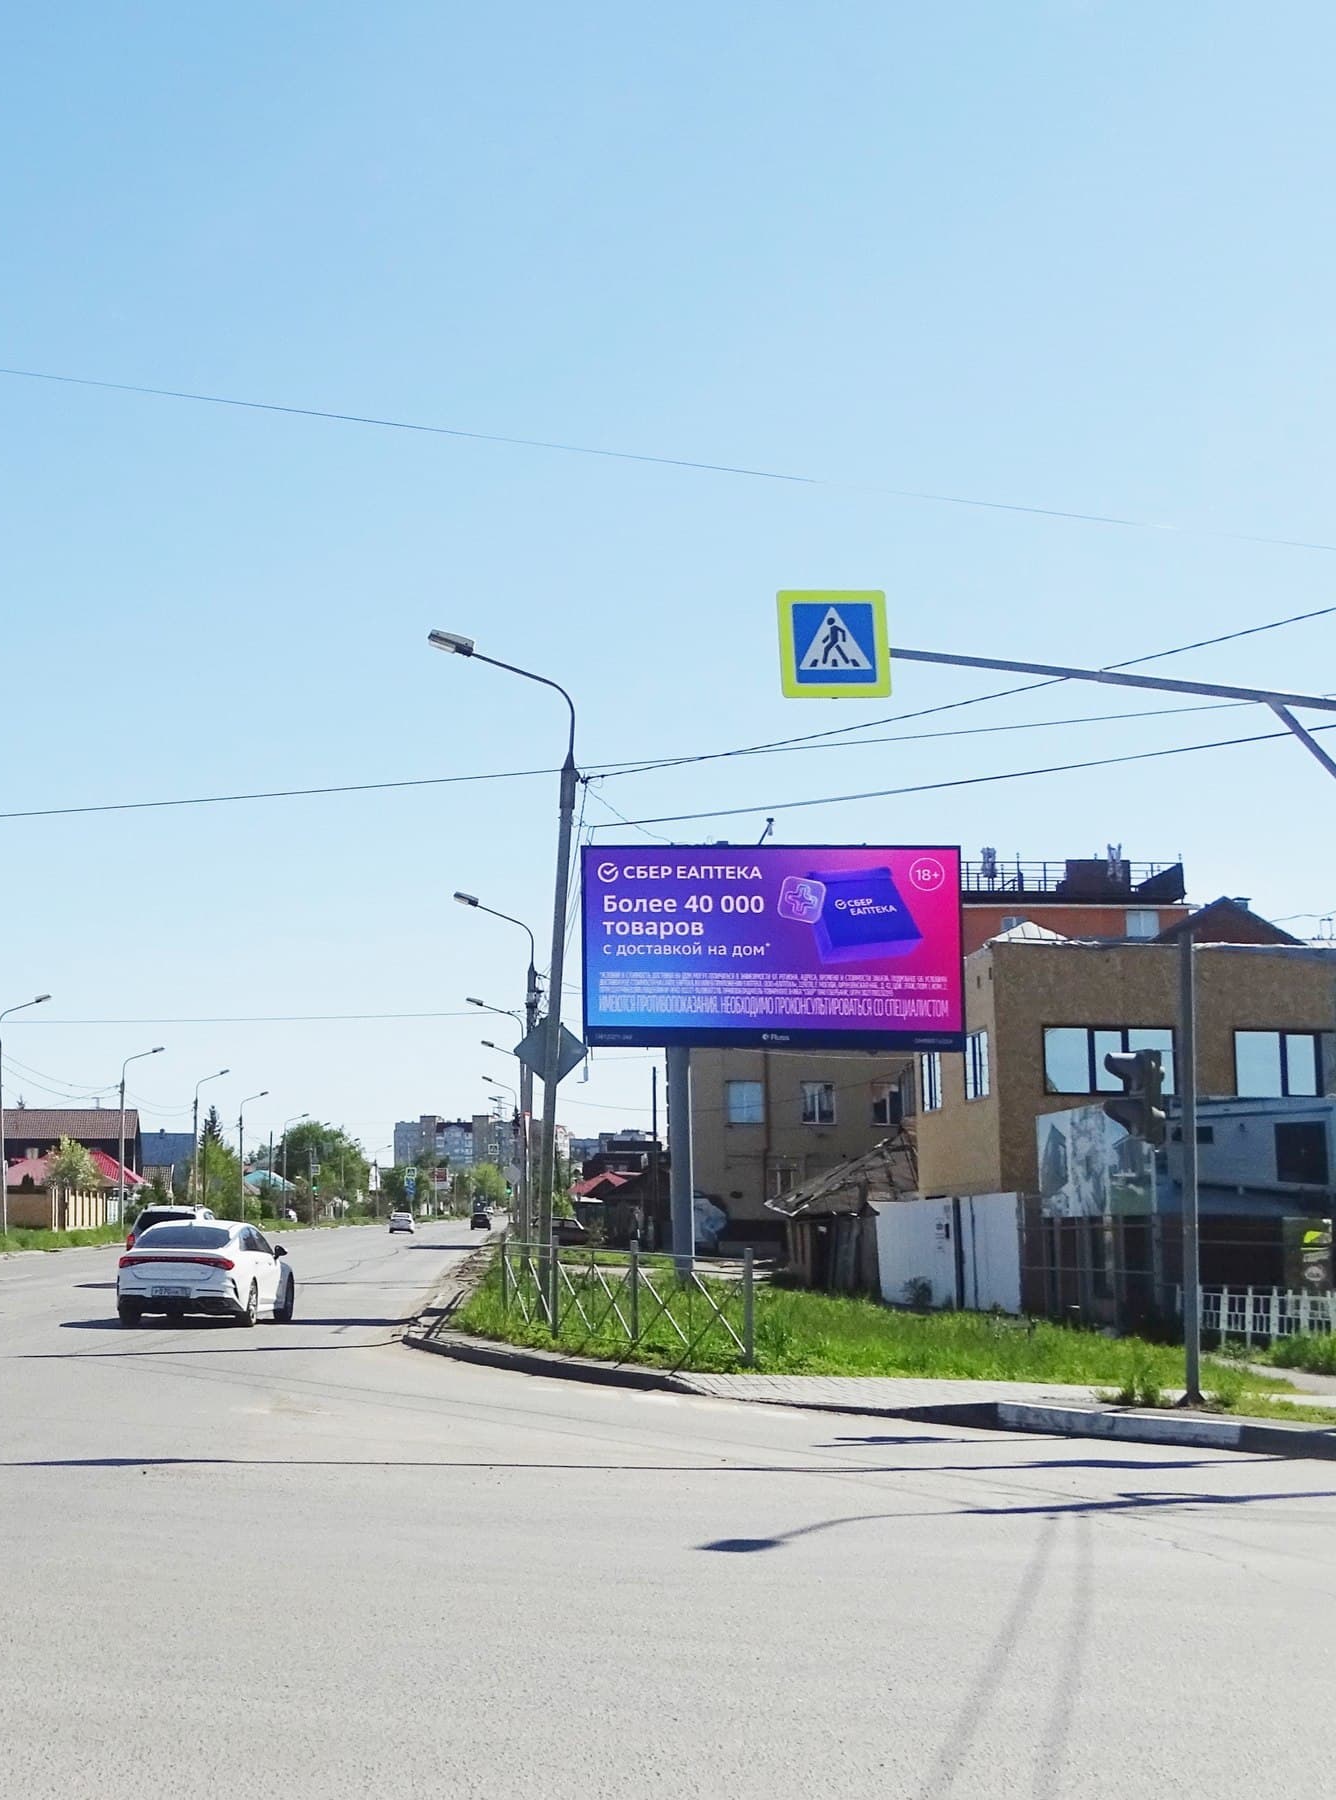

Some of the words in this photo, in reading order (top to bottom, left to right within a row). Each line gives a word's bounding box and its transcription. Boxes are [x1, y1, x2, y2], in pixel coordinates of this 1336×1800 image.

[623, 866, 672, 879] СБЕР
[676, 866, 762, 879] ЕАПТЕКА
[915, 869, 939, 881] 18+
[603, 895, 677, 913] Более
[684, 895, 713, 913] 40
[720, 895, 764, 913] 000
[847, 898, 872, 907] СБЕР
[849, 905, 897, 916] ЕАПТЕКА
[602, 921, 704, 939] товаров
[603, 944, 611, 955] с
[616, 942, 702, 957] доставкой
[708, 945, 726, 956] на
